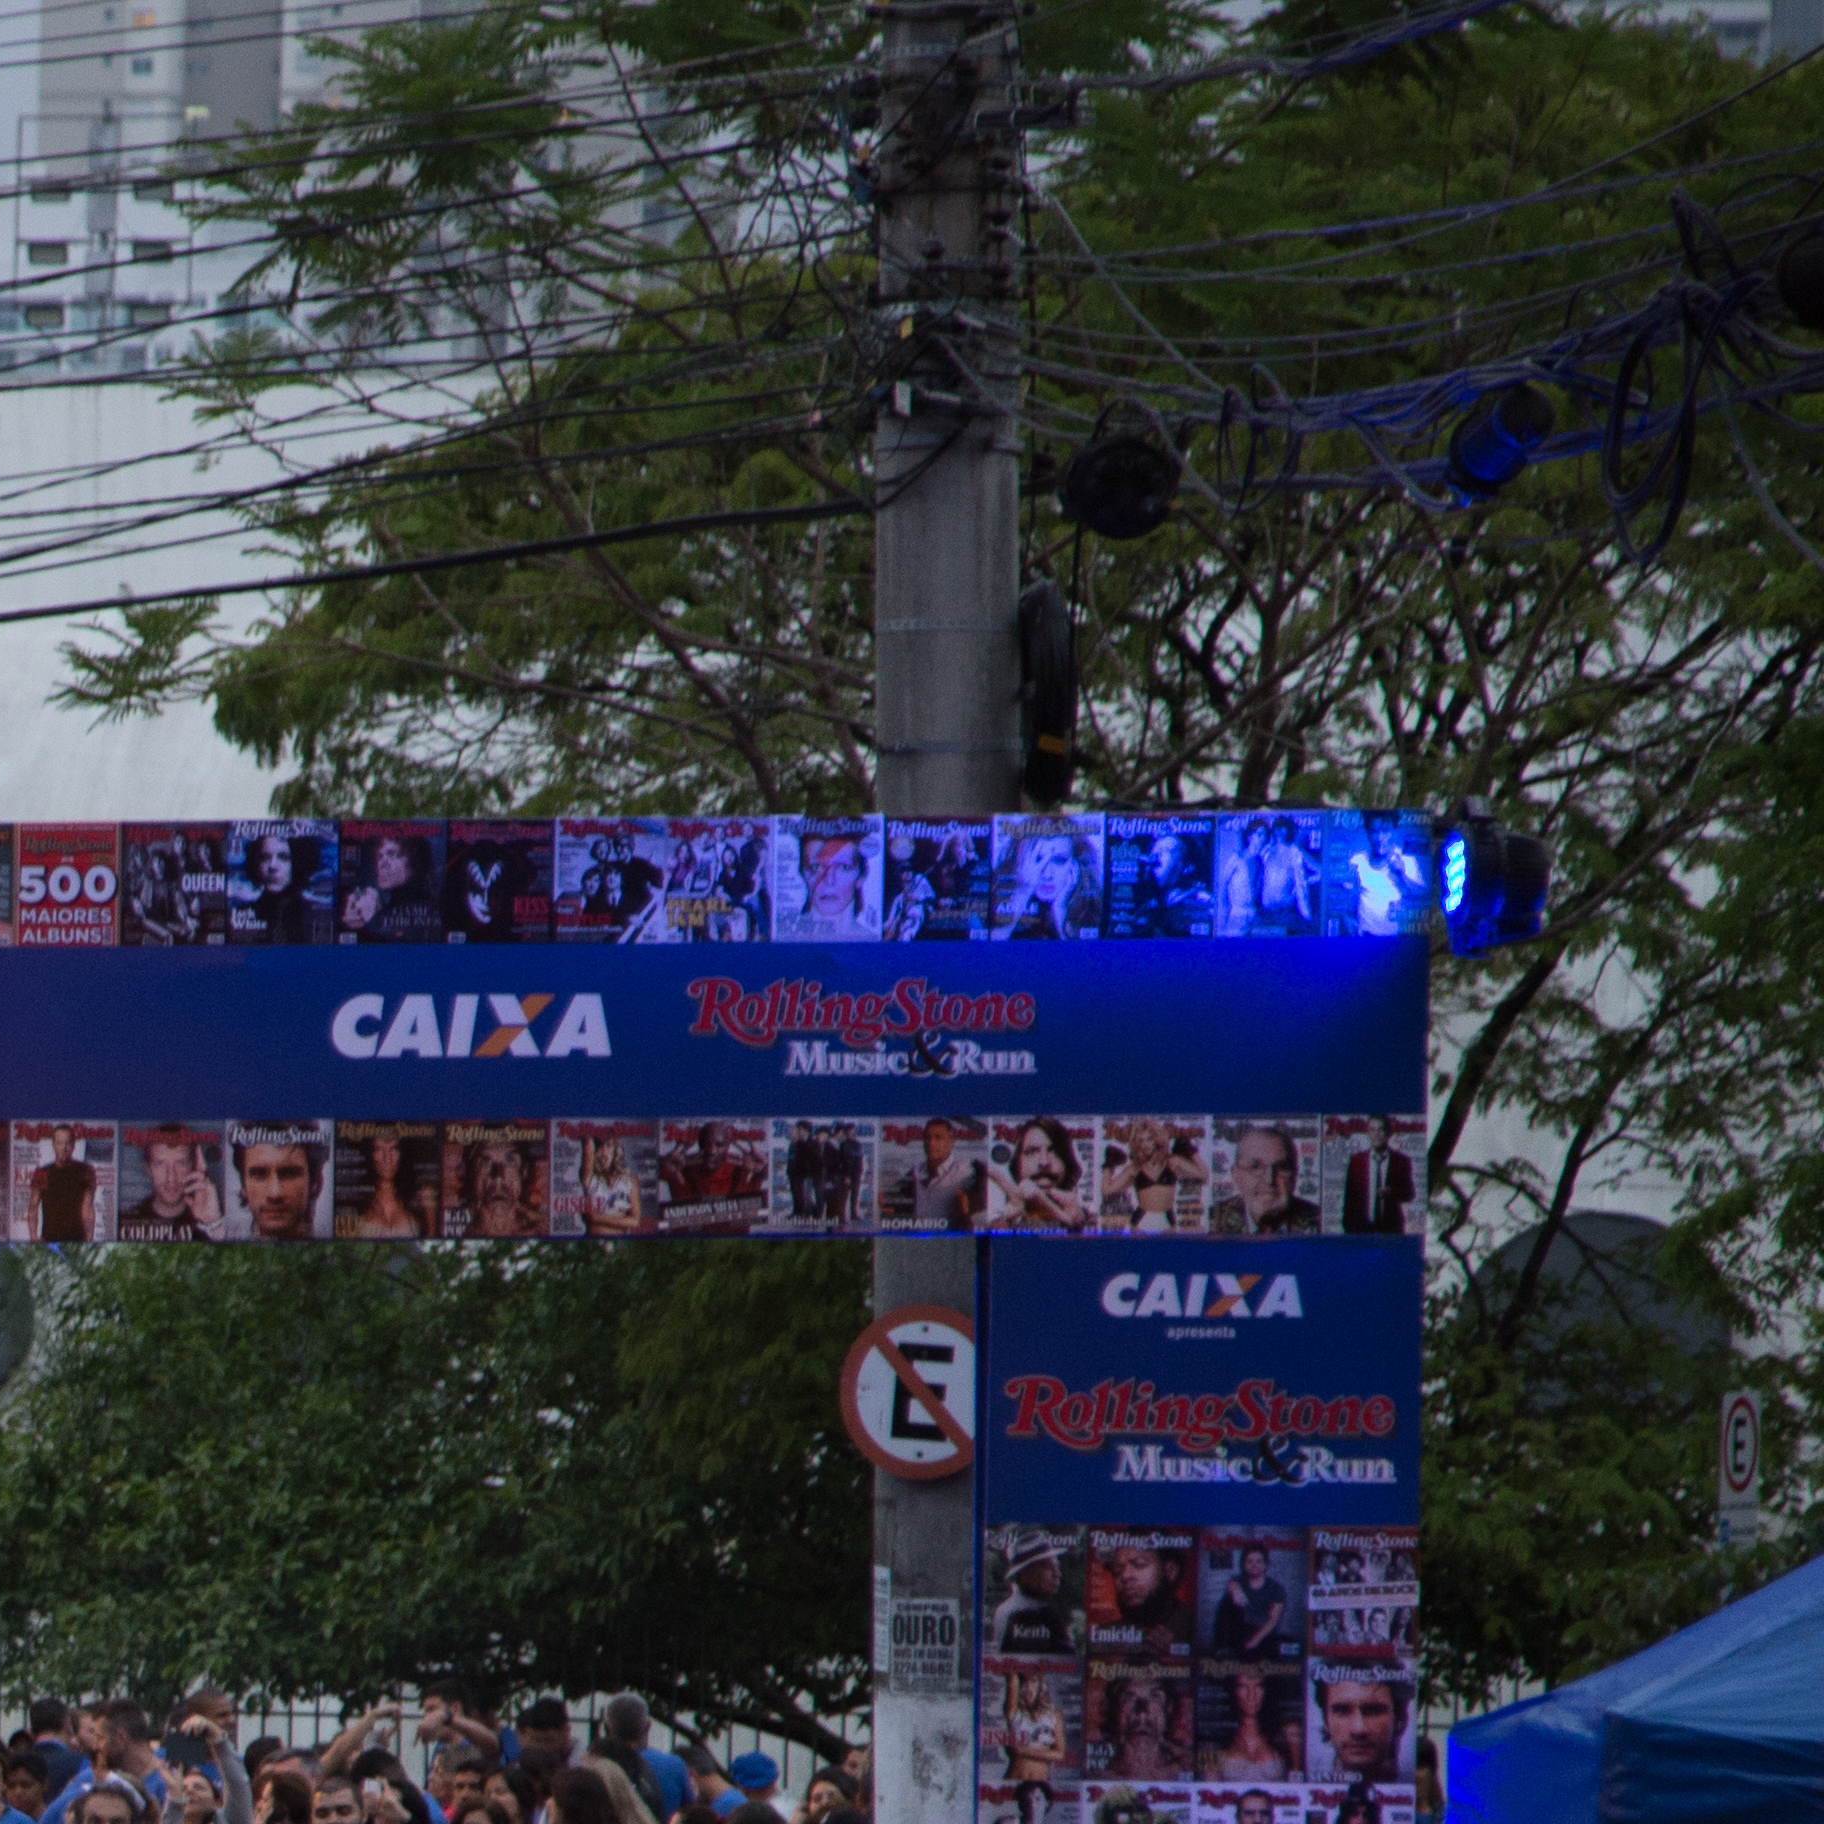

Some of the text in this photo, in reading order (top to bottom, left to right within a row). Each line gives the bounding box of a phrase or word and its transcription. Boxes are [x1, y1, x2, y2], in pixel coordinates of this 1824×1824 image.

[19, 865, 118, 905] 500
[182, 873, 226, 893] QUEEN
[20, 908, 112, 925] MAIORES
[514, 897, 548, 915] KISS
[667, 899, 731, 914] PEARL
[330, 992, 613, 1058] CAIXA
[686, 976, 1036, 1047] Rolling Stone
[785, 1031, 1038, 1078] Music & Run
[120, 1224, 192, 1241] COLDPLAY
[1101, 1273, 1303, 1319] CAIXA
[1166, 1326, 1236, 1339] apresenta
[889, 1342, 955, 1440] E
[1005, 1375, 1397, 1451] Rolling Stone
[1111, 1437, 1398, 1487] Music & Run
[1732, 1416, 1748, 1473] E
[892, 1614, 957, 1646] OURO
[1013, 1623, 1051, 1639] Keith
[1090, 1624, 1144, 1645] Emicida
